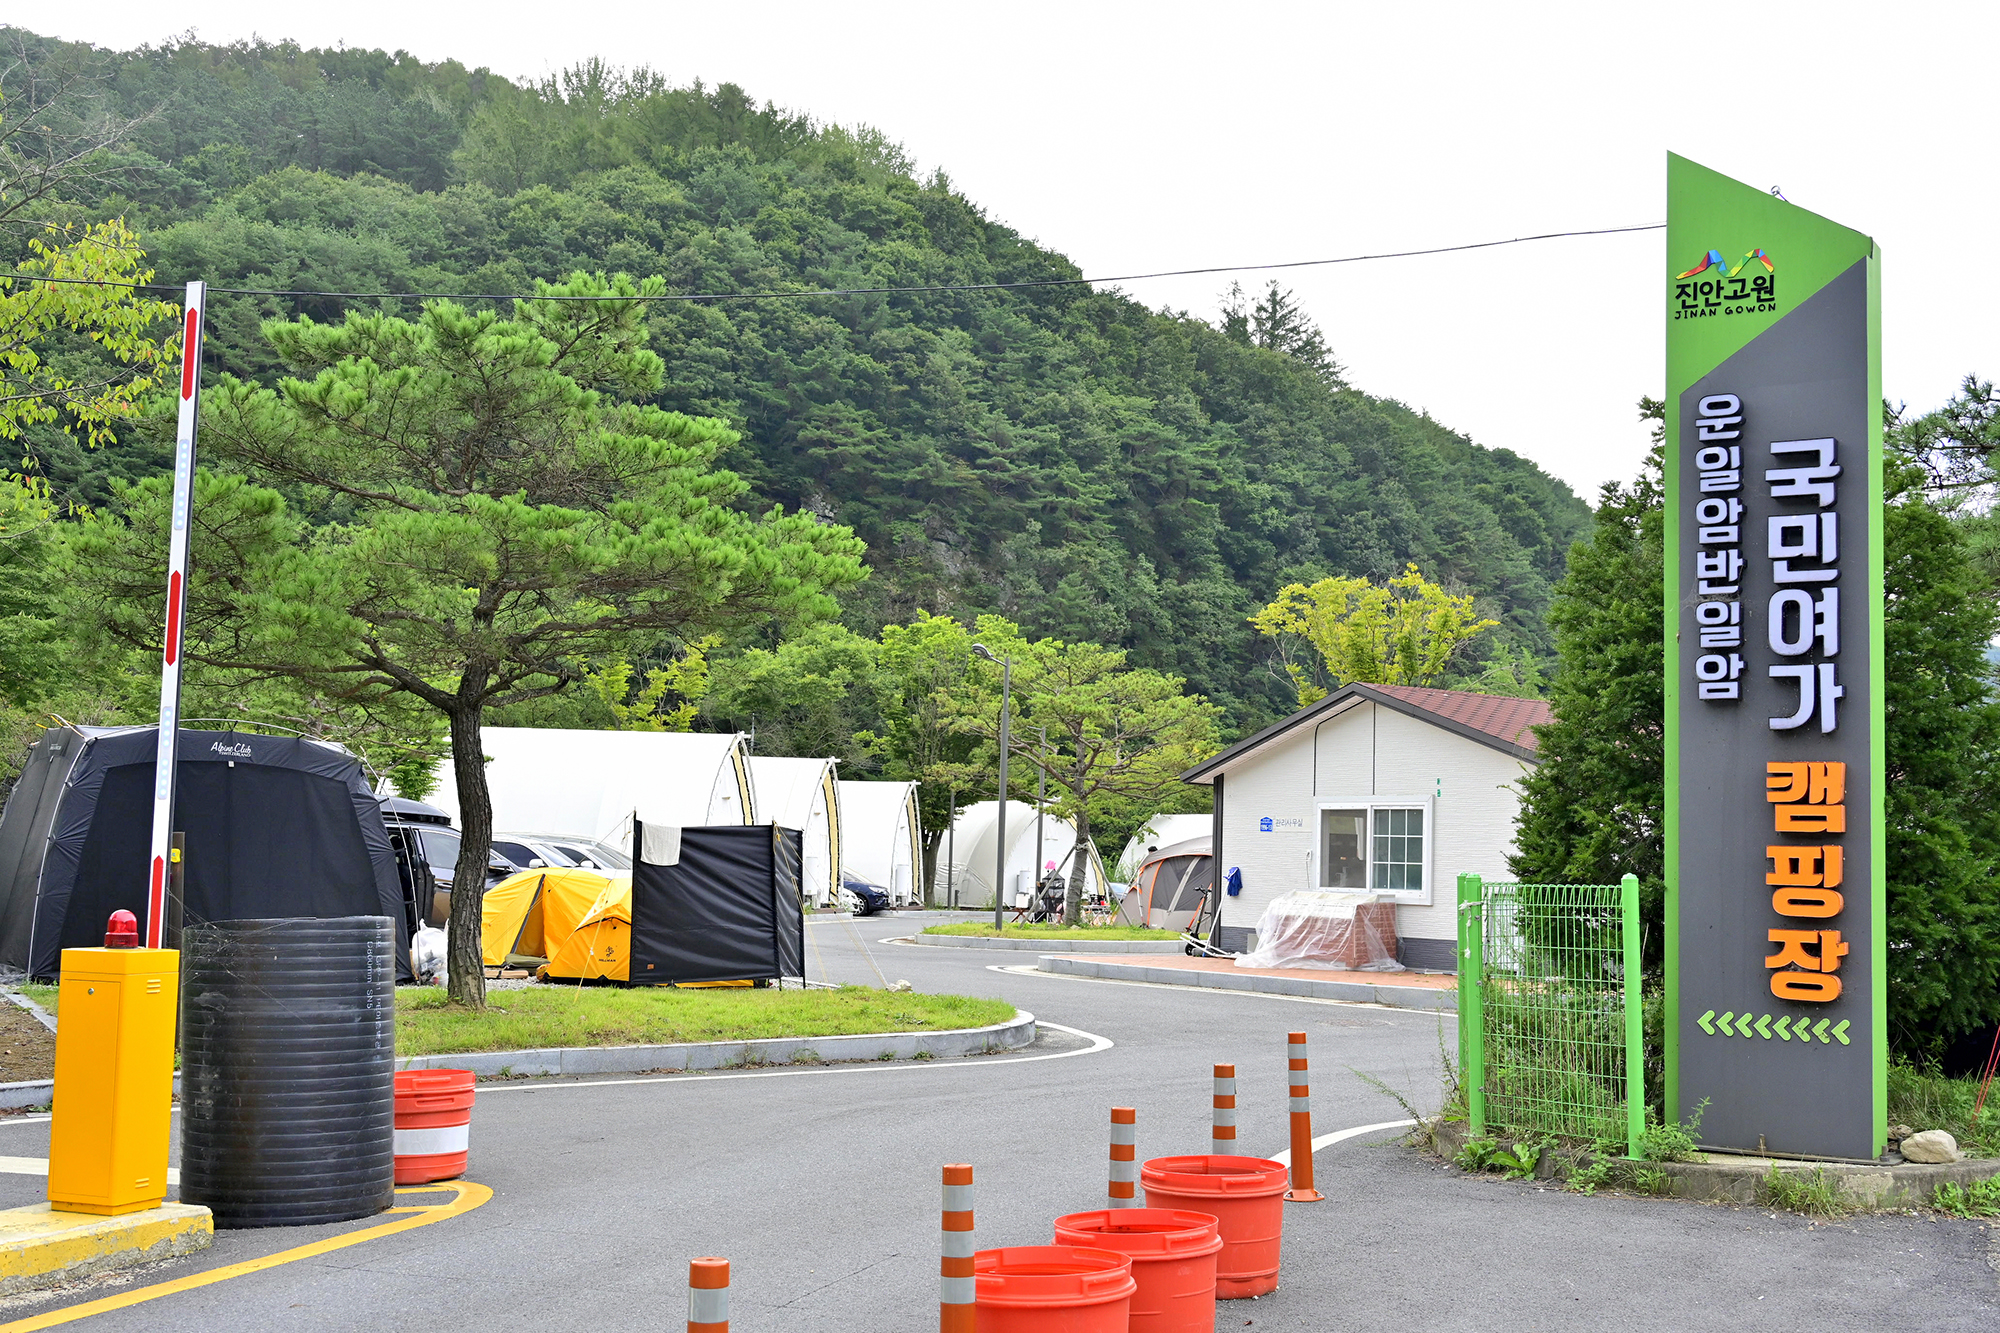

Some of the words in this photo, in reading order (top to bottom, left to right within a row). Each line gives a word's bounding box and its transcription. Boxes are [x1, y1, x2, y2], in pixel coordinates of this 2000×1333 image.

[1675, 274, 1775, 309] 진안고원
[1674, 308, 1717, 320] JINAN
[1724, 303, 1777, 315] GOWON
[1695, 393, 1747, 701] 운일암반일암
[1764, 437, 1844, 735] 국민여가
[210, 742, 233, 752] Alpine
[234, 742, 251, 753] Club
[1275, 818, 1303, 827] 관리사무실
[1764, 761, 1849, 1002] 캠핑장
